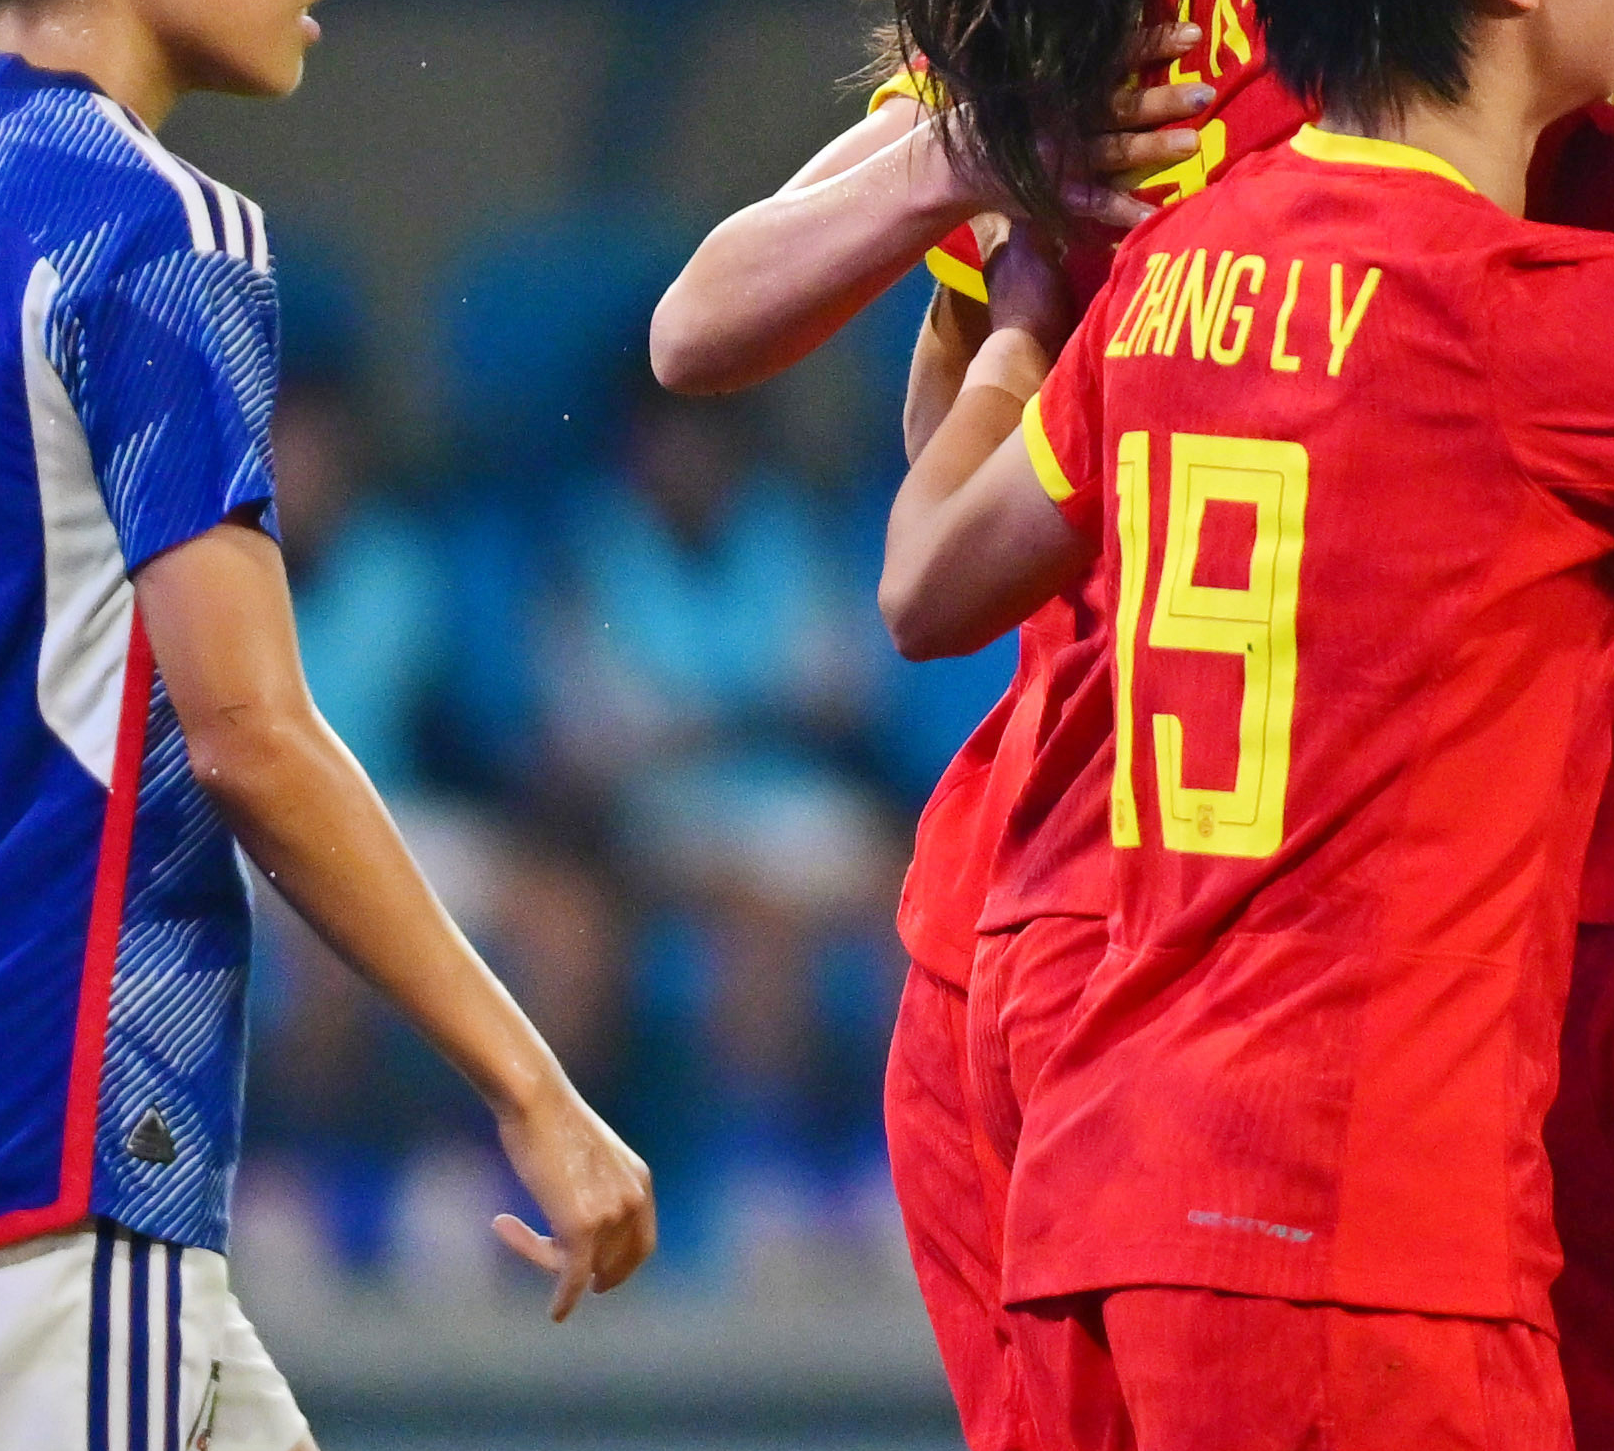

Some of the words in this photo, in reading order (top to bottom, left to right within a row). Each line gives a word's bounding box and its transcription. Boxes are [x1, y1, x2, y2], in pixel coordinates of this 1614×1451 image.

[1105, 247, 1267, 366] ZHANG
[1270, 259, 1383, 377] LY
[1111, 430, 1310, 858] 19
